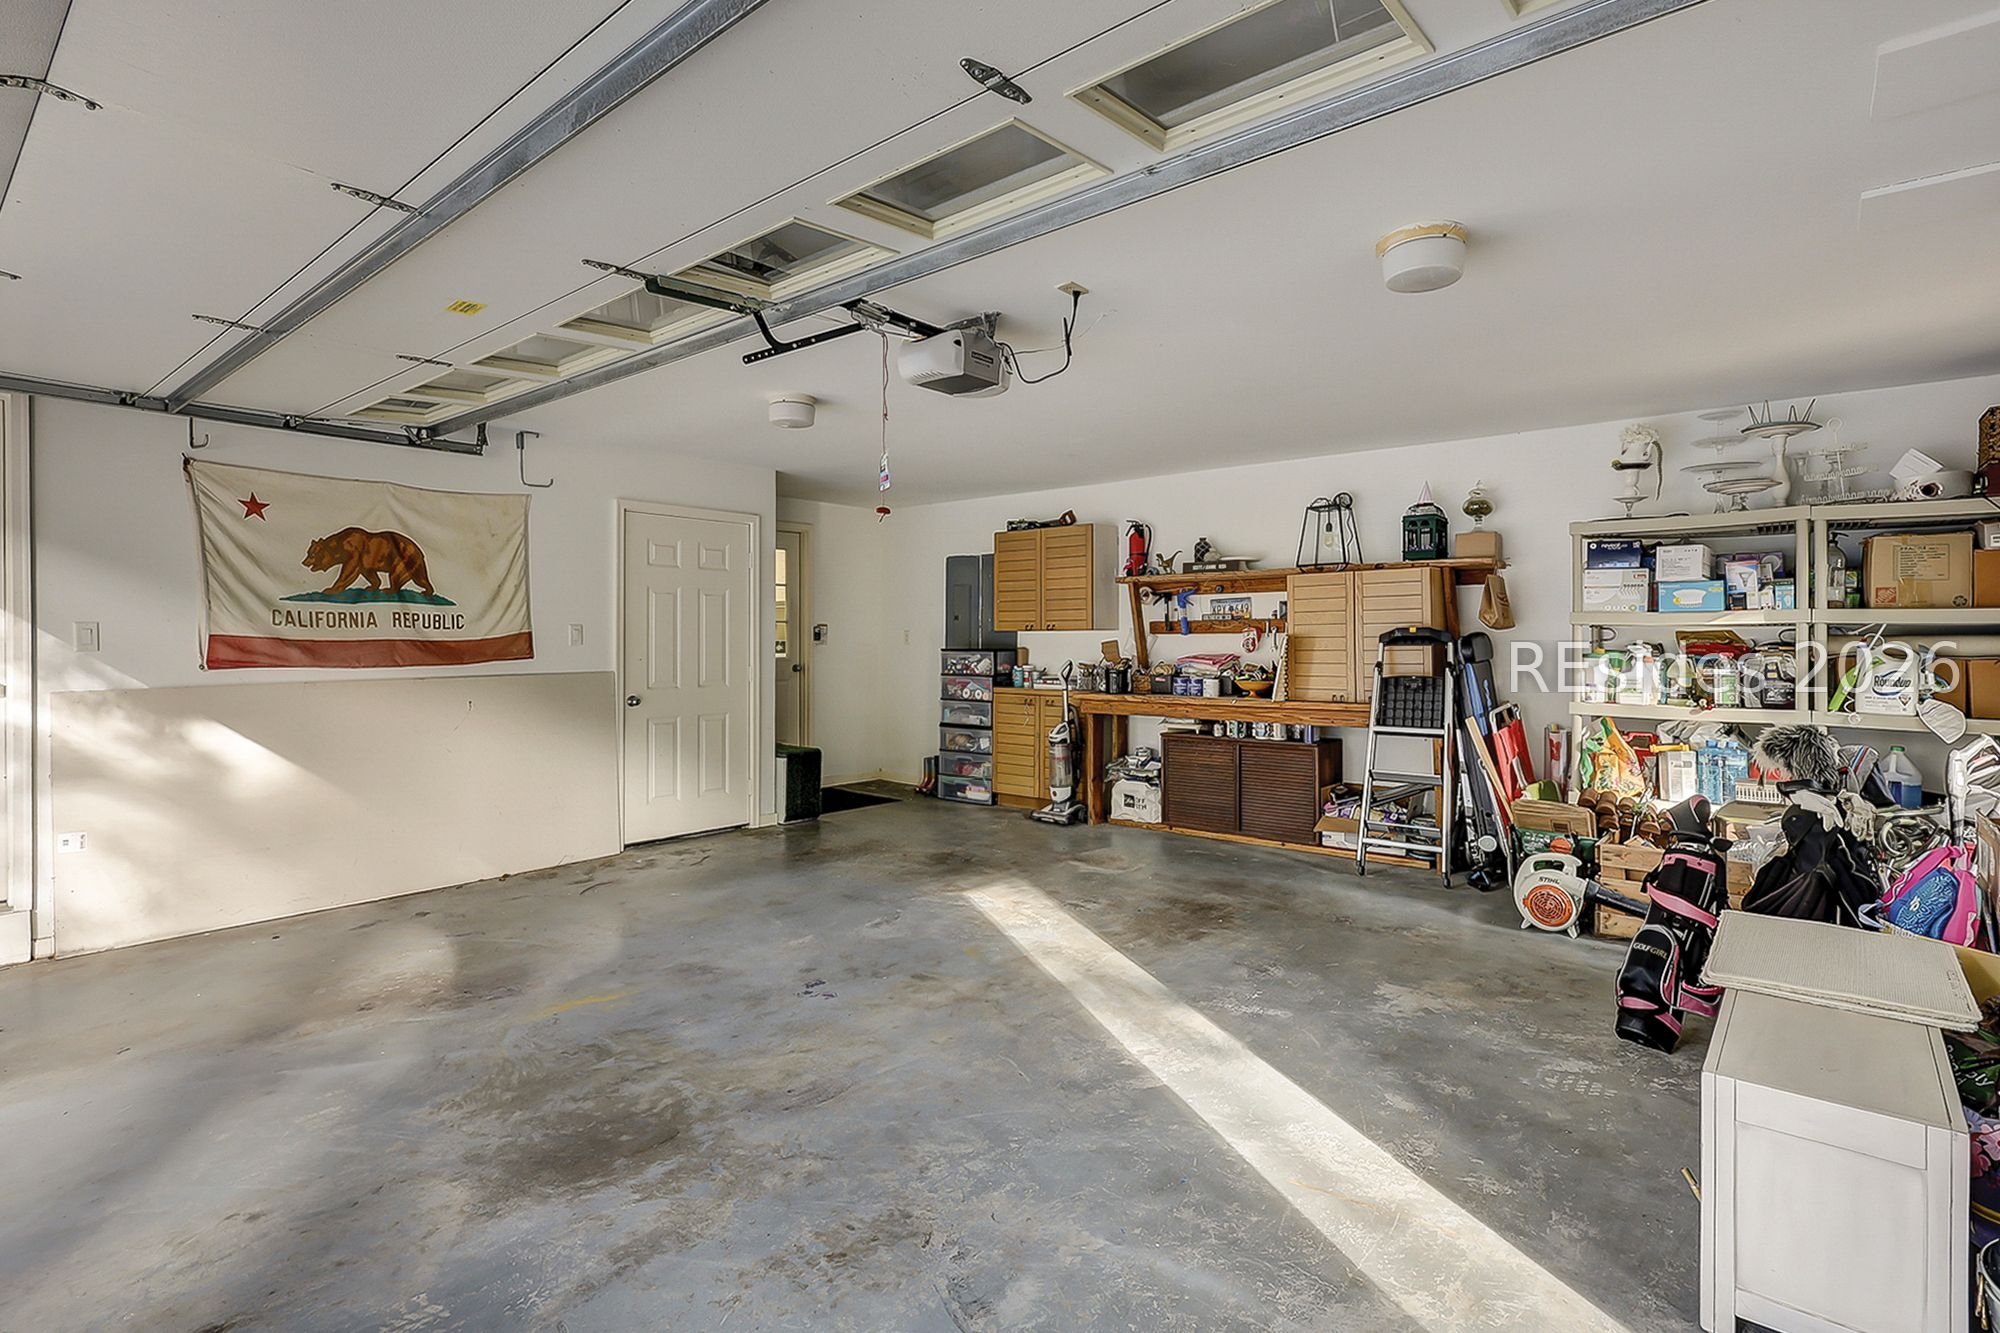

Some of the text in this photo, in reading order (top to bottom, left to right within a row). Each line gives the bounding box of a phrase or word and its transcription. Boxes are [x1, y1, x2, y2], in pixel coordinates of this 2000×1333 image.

[272, 609, 465, 629] CALIFORNIA REPUBLIC
[1538, 876, 1560, 885] STIHL
